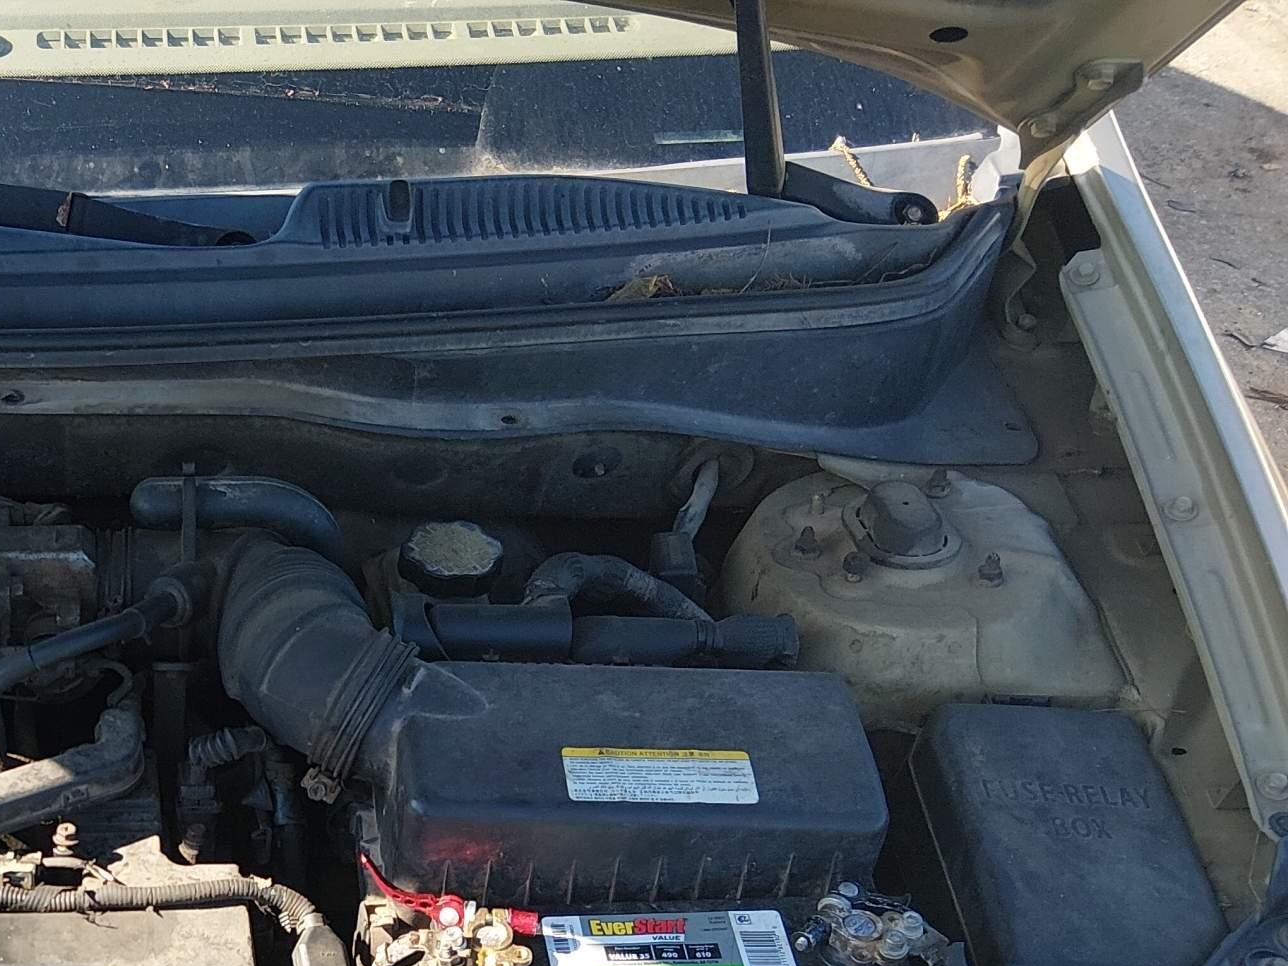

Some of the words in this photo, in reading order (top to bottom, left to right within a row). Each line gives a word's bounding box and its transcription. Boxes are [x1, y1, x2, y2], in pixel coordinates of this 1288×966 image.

[1051, 816, 1113, 840] BOX
[588, 917, 687, 936] EverStart
[608, 952, 638, 960] VALUE
[639, 952, 650, 960] 35
